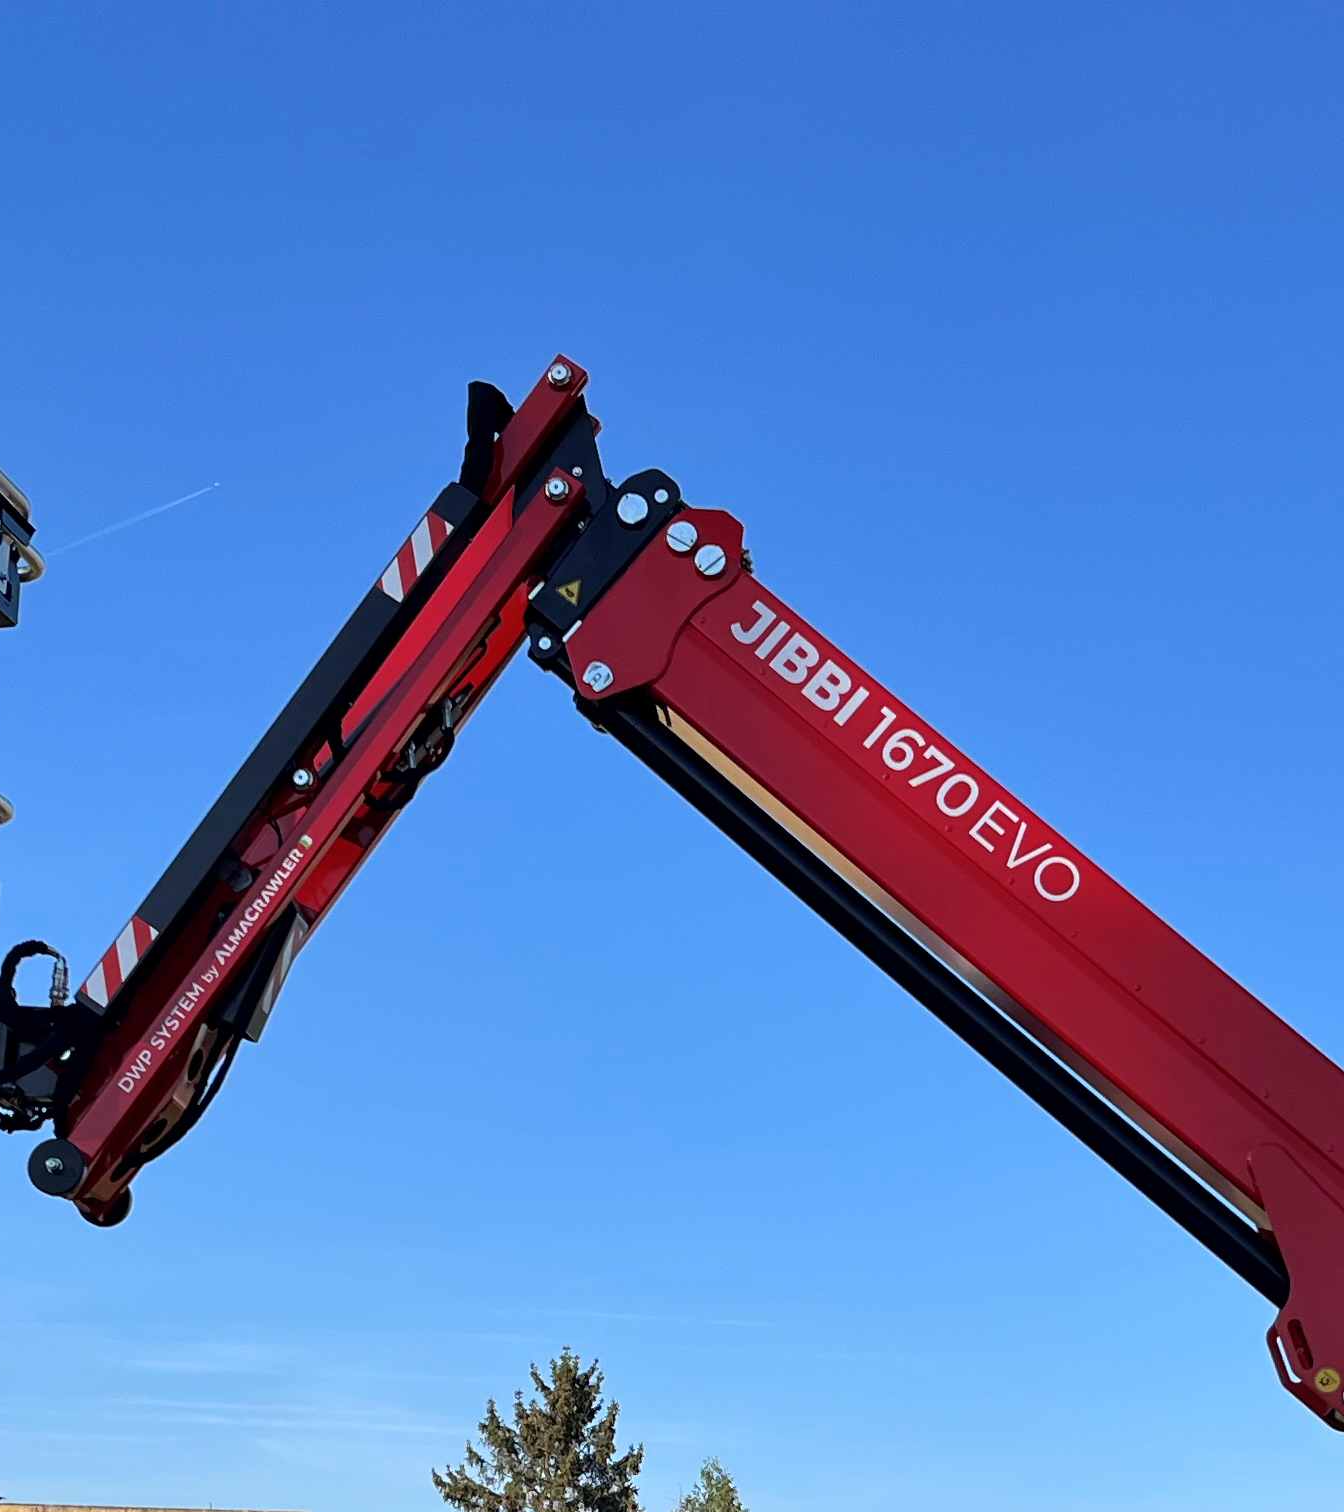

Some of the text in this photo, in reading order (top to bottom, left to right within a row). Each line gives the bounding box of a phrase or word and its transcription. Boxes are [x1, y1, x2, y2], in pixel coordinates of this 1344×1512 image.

[730, 600, 1081, 902] JIBBI 1670 EVO
[117, 849, 304, 1095] DWP SYSTEM by ALMACRAWLER
